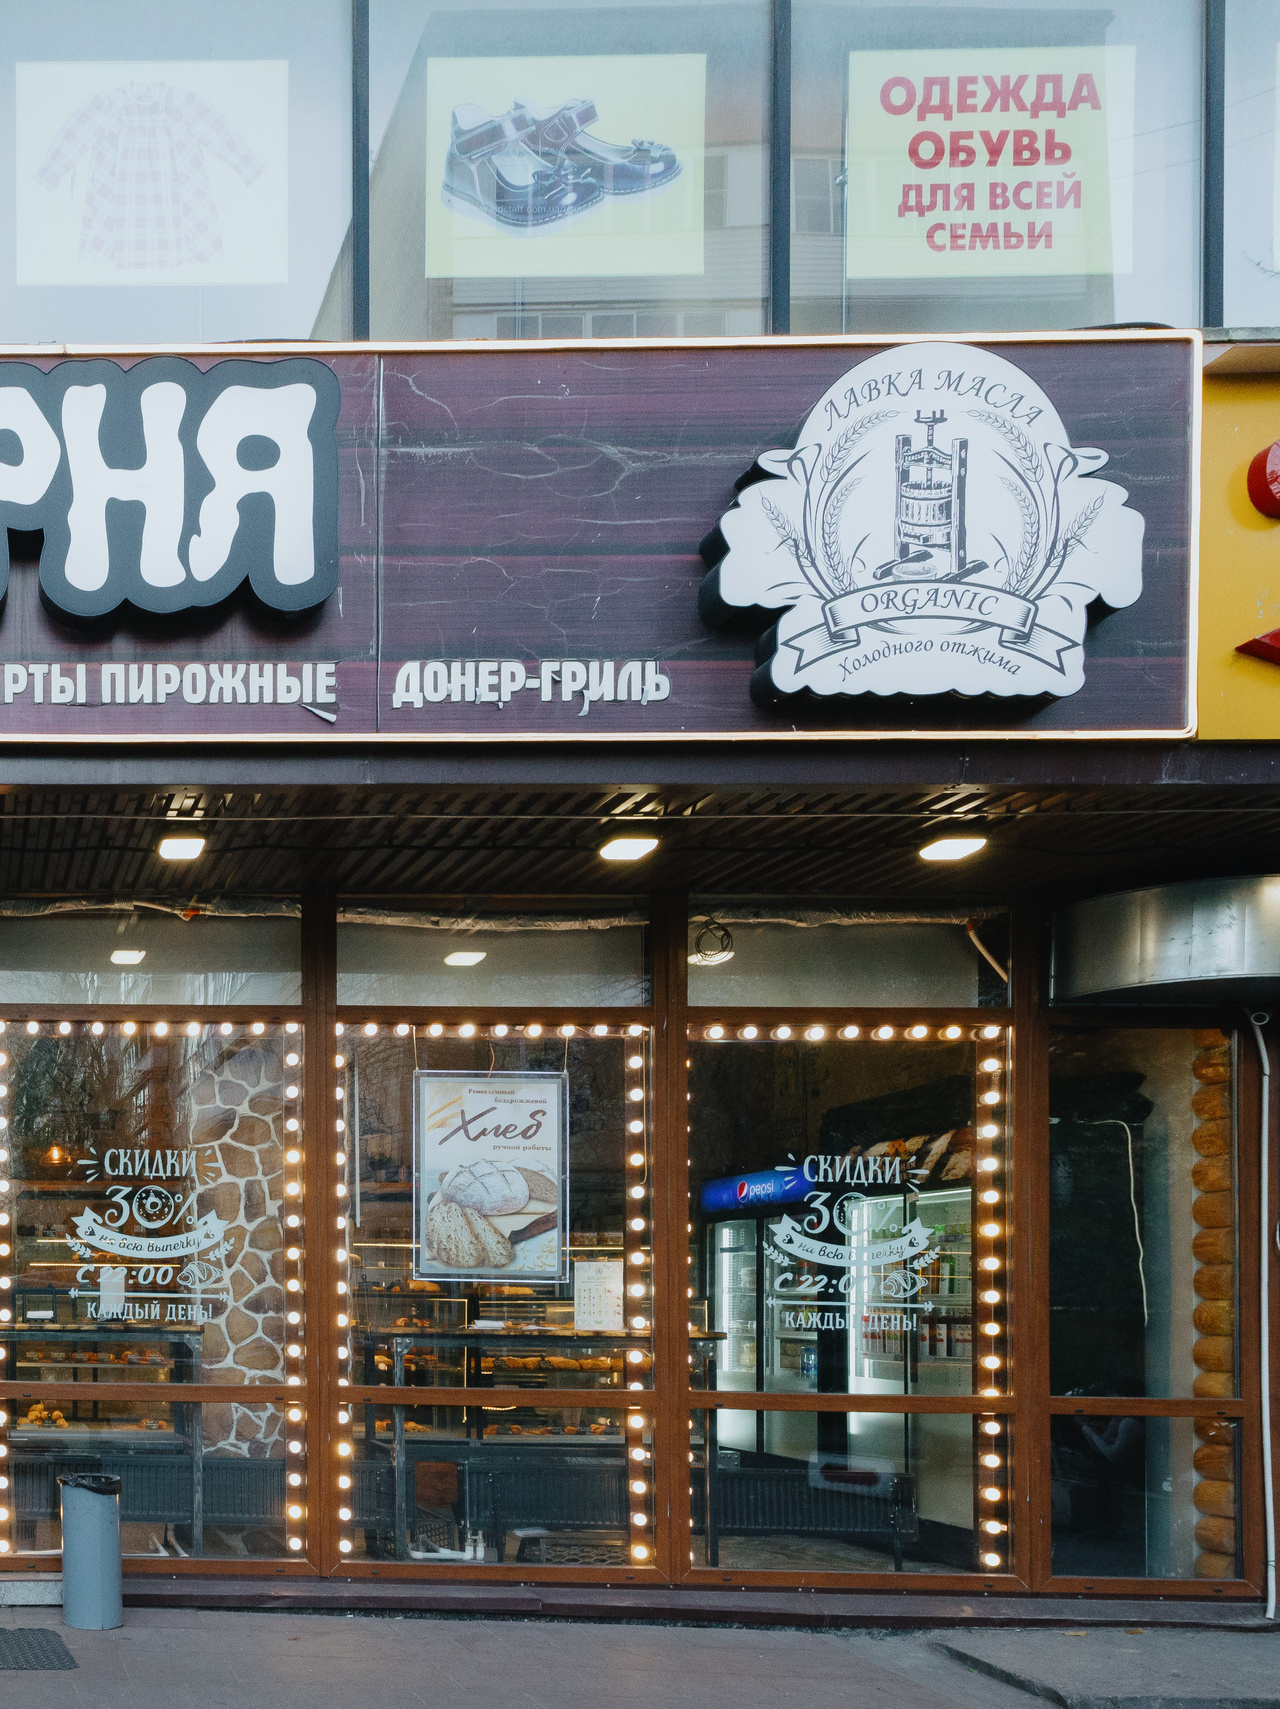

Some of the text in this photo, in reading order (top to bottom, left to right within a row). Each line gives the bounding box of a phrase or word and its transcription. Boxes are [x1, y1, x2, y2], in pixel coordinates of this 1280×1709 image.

[879, 73, 1102, 122] ОДЕЖДА
[908, 129, 1072, 170] ОБУВЬ
[897, 172, 1082, 218] ДЛЯ ВСЕЙ
[925, 221, 1053, 252] СЕМЬИ
[824, 369, 1045, 432] ЛАВКА МАСЛА
[860, 587, 1000, 617] ORGANIC
[837, 637, 1022, 682] Холодного отжима
[101, 663, 337, 706] ПИРОЖНЫЕ
[392, 660, 671, 708] ДОНЕР-ГРИЛЬ
[438, 1106, 547, 1145] Хлеб
[104, 1149, 197, 1180] СКИДКИ
[803, 1154, 902, 1187] СКИДКИ
[104, 1185, 197, 1229] 30%
[750, 1180, 774, 1199] pepsi
[803, 1191, 898, 1236] 30%
[99, 1234, 116, 1246] на
[118, 1237, 144, 1252] всю
[818, 1246, 846, 1260] всю
[97, 1266, 174, 1285] 22:00
[86, 1300, 213, 1322] КАЖДЫЙ ДЕНЬ!
[785, 1311, 917, 1331] КАЖДЫ ДЕНЬ!
